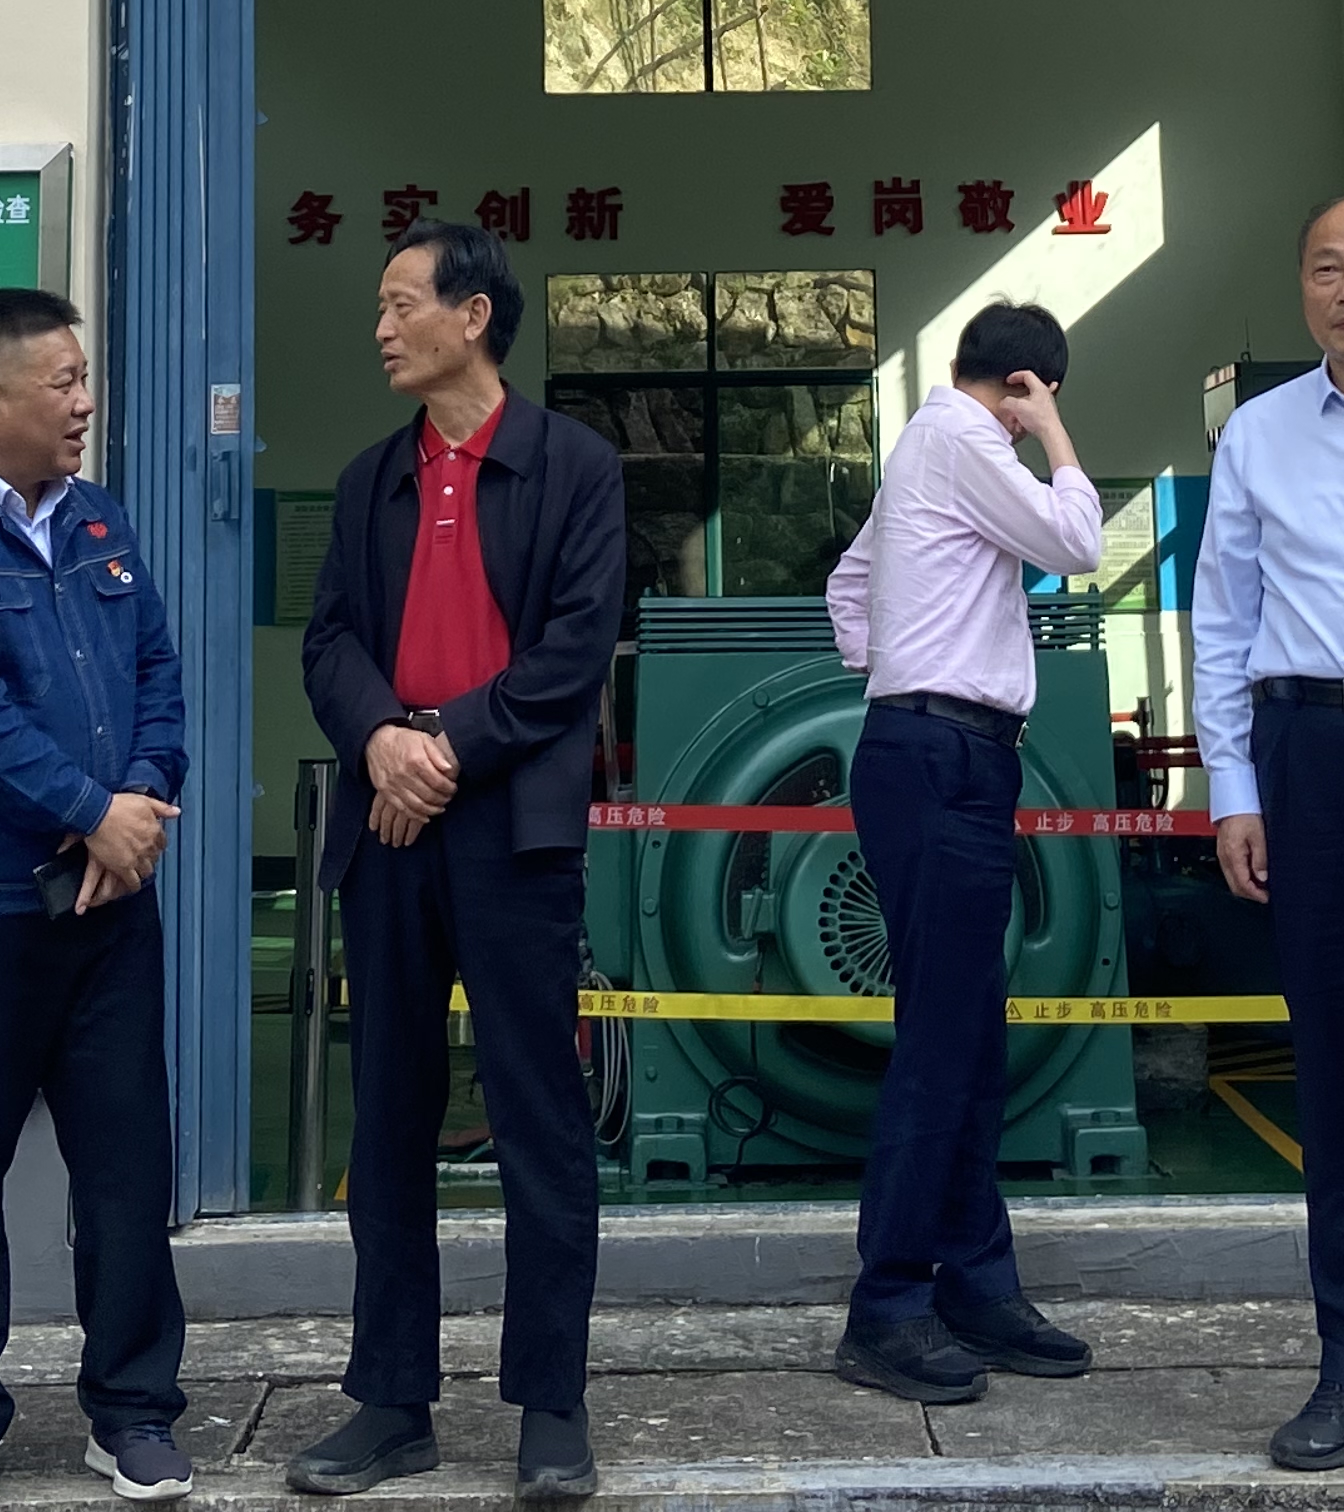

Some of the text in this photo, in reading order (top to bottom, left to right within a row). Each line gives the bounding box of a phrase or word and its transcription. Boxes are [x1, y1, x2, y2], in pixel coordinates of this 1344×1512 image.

[780, 177, 1112, 236] 爱岗敬业
[588, 805, 666, 826] 高压危险
[1035, 813, 1174, 832] 止步 高压危险
[578, 993, 659, 1013] 高压危险
[1034, 1001, 1172, 1019] 止步 高压危险
